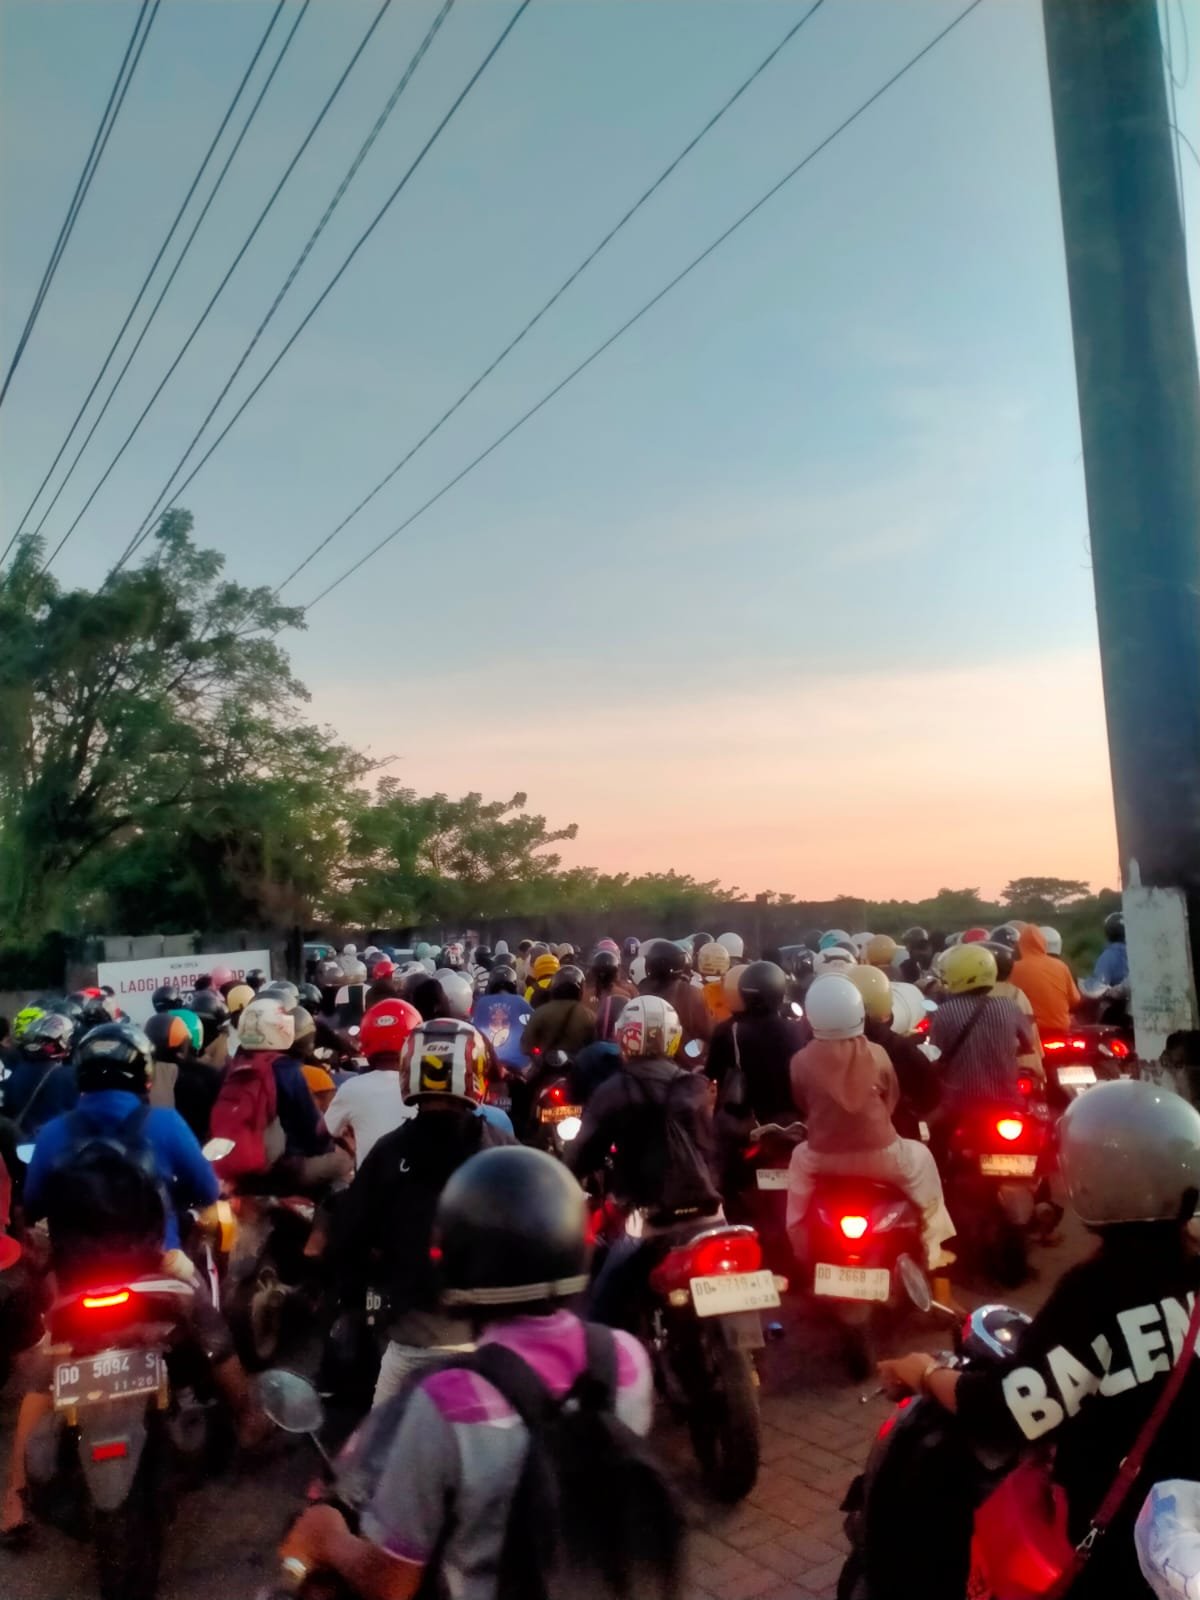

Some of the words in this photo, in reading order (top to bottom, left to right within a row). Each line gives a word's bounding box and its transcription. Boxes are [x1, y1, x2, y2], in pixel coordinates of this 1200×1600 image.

[60, 1366, 80, 1386] DD
[93, 1356, 130, 1379] 5094
[145, 1352, 155, 1369] S
